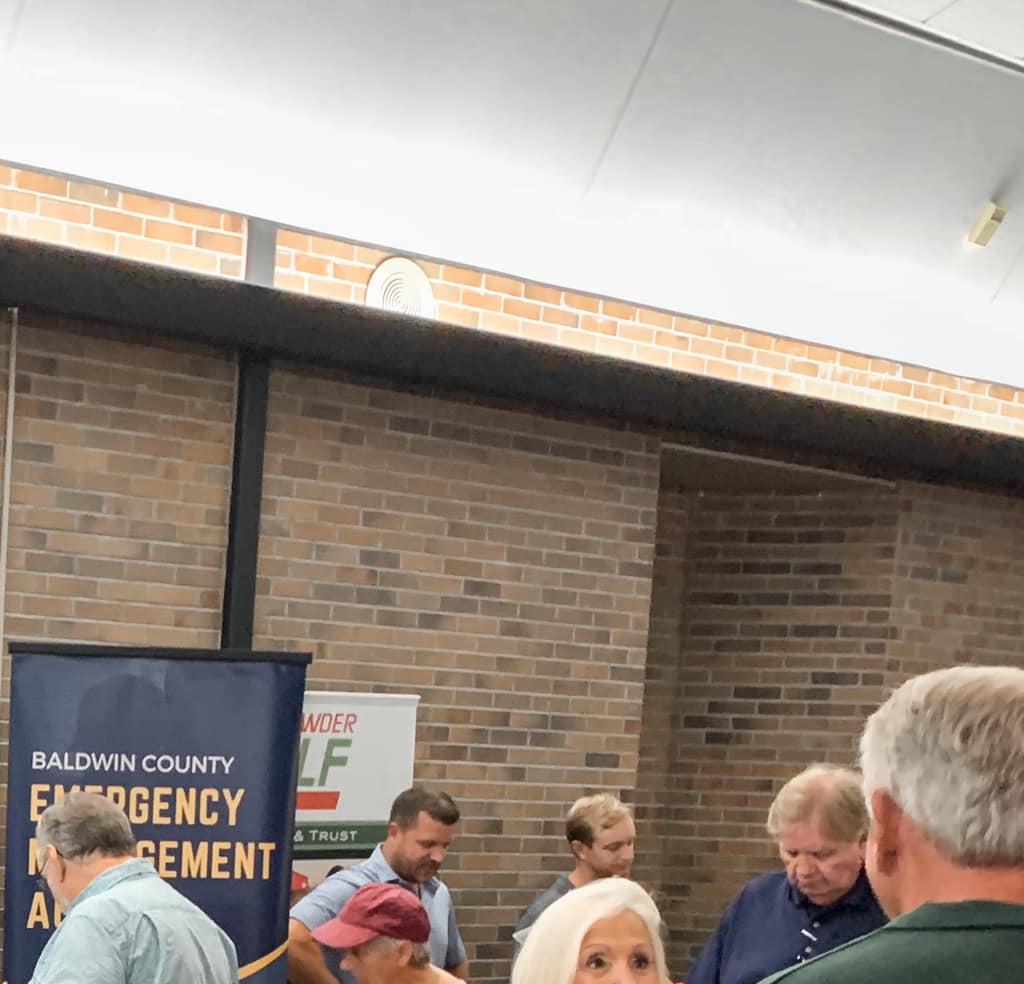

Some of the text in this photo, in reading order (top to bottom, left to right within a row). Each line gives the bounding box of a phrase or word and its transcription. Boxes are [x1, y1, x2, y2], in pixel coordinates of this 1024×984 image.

[299, 712, 358, 734] WDER
[32, 751, 234, 774] BALDWIN COUNTY
[298, 738, 353, 787] LF
[29, 784, 245, 827] ERGENCY
[293, 829, 358, 842] & TRUST
[28, 837, 276, 880] GEMENT
